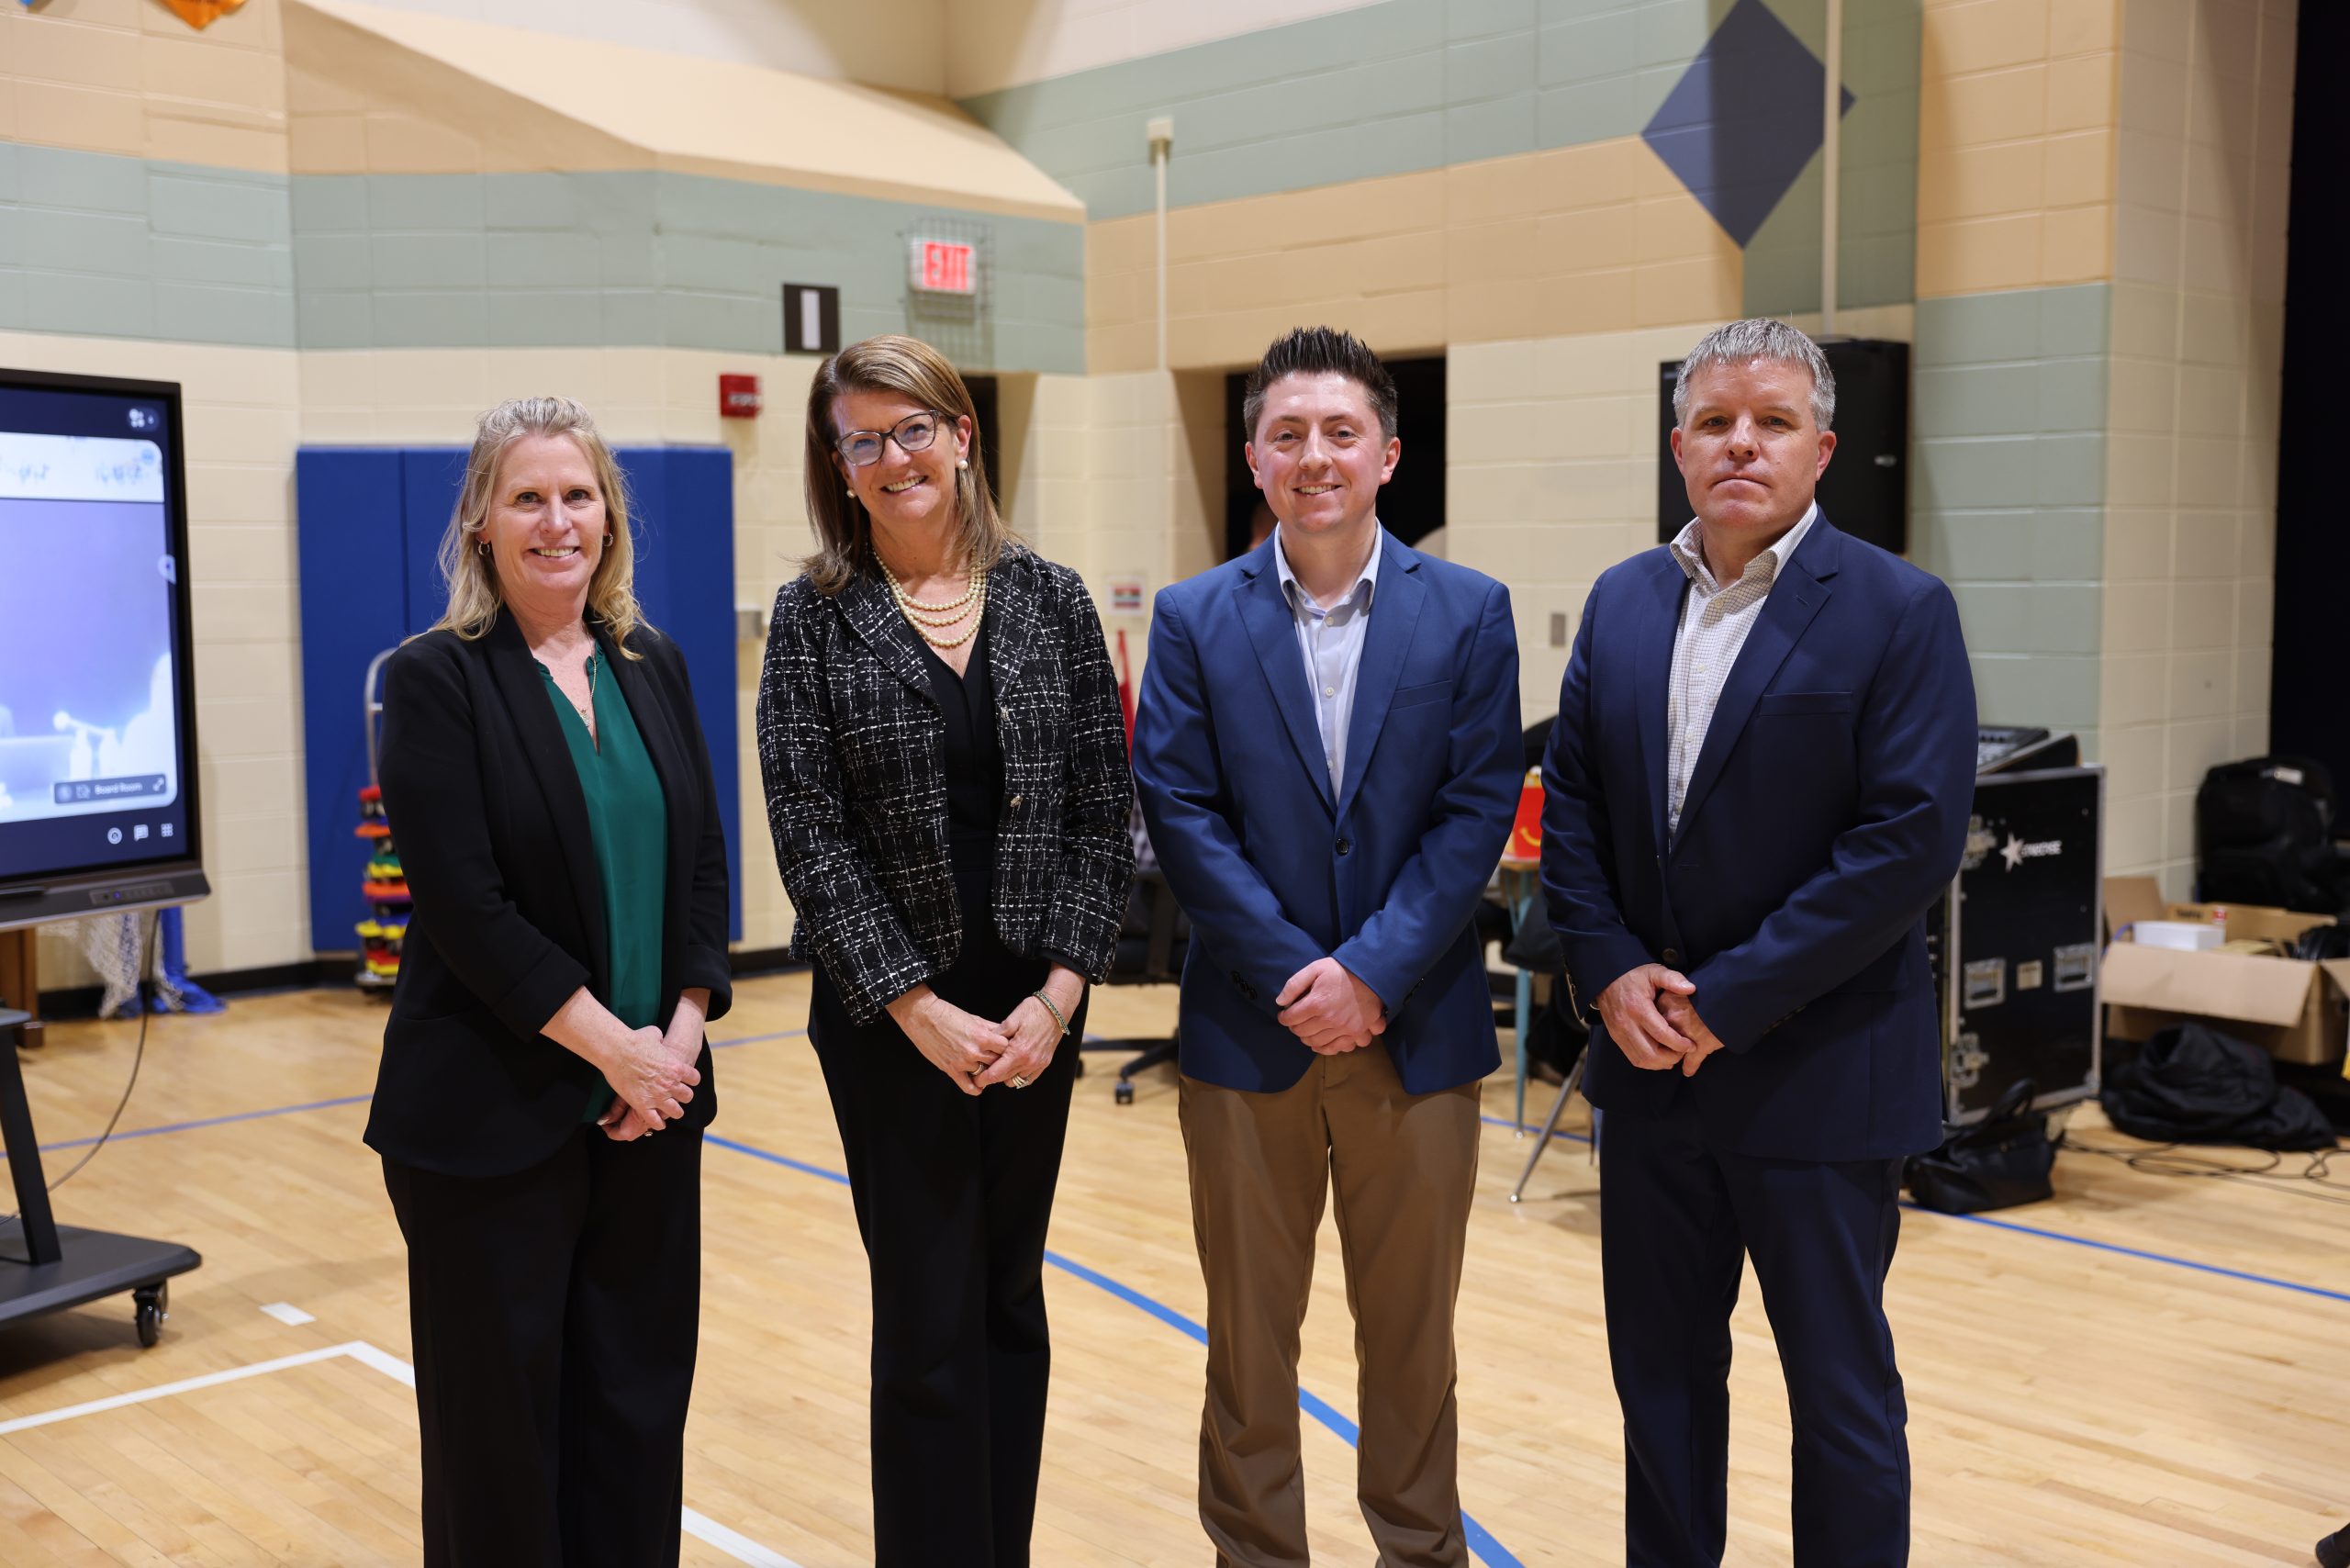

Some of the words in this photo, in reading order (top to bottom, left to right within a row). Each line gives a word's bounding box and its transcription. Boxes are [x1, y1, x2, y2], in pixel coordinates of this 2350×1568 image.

[924, 241, 969, 290] EXIT
[94, 783, 118, 795] Board
[119, 781, 143, 792] Room
